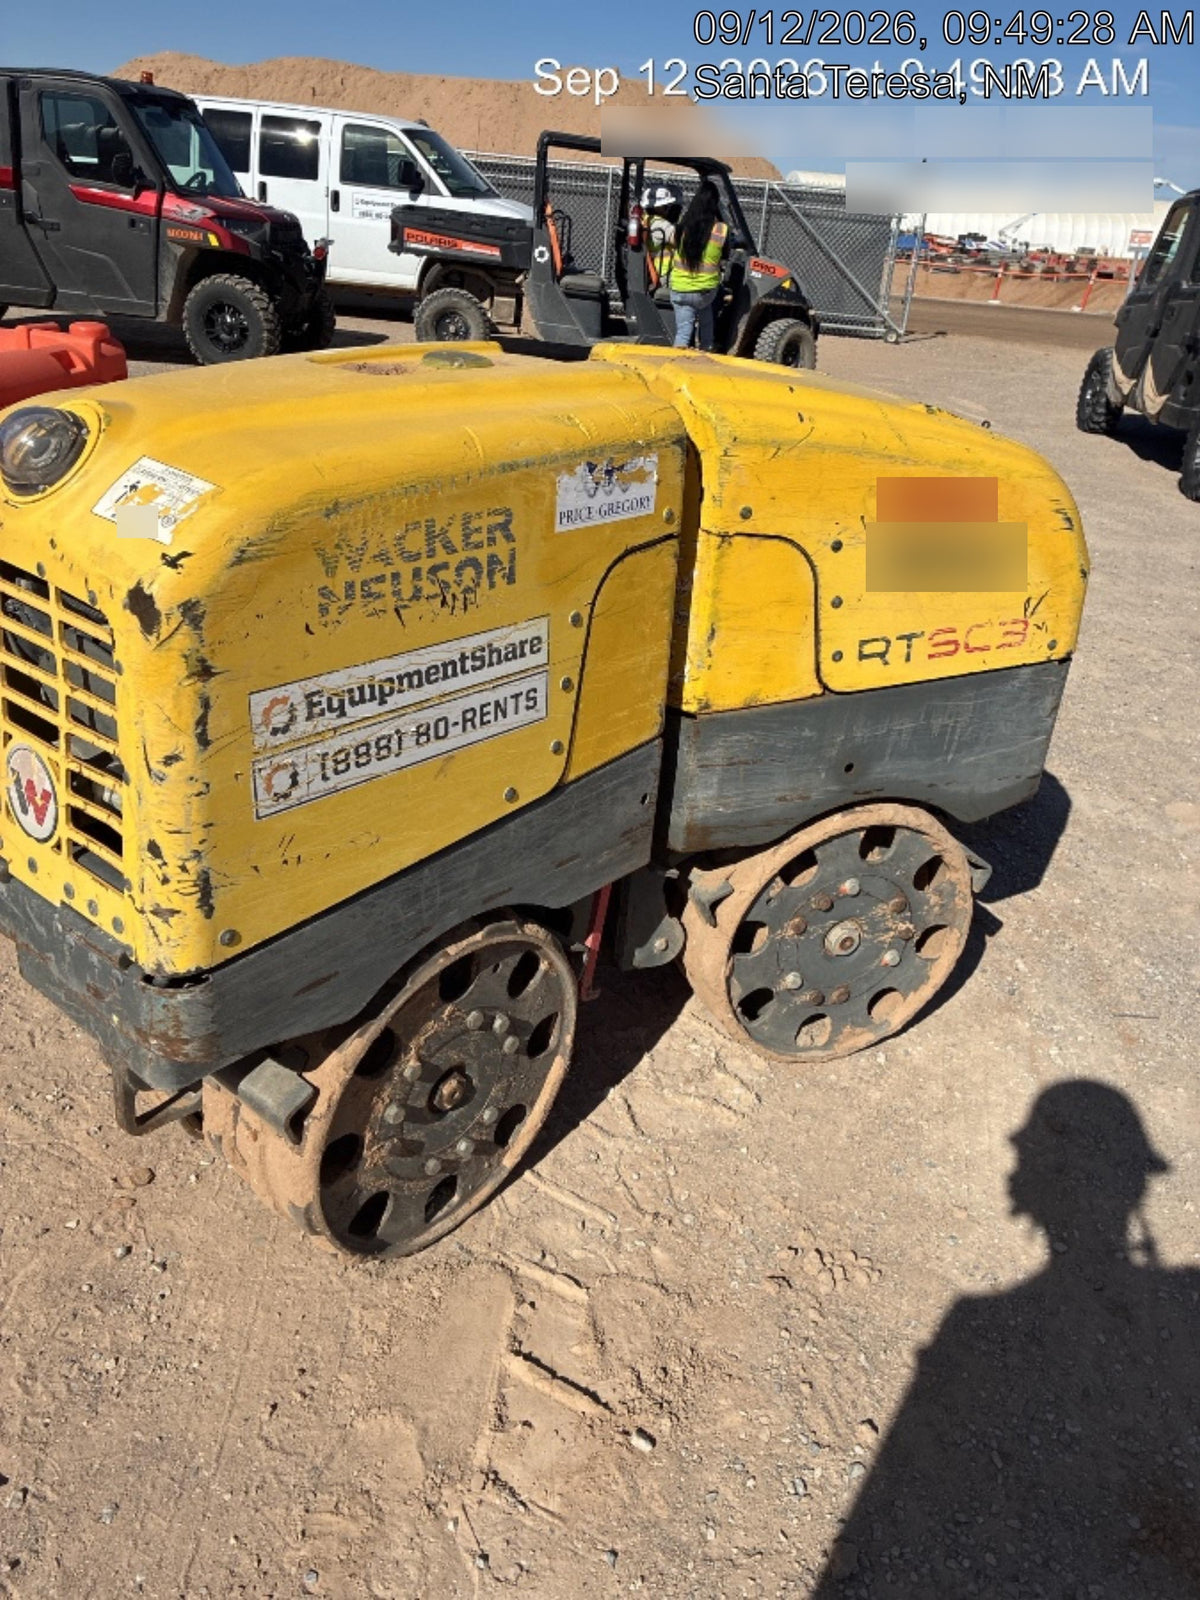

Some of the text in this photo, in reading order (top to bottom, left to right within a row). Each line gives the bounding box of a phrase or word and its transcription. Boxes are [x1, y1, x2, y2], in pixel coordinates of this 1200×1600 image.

[406, 232, 458, 249] POLARIS
[753, 260, 776, 275] PRO
[303, 634, 543, 722] EquipmentShare
[415, 686, 539, 747] 80-RENTS
